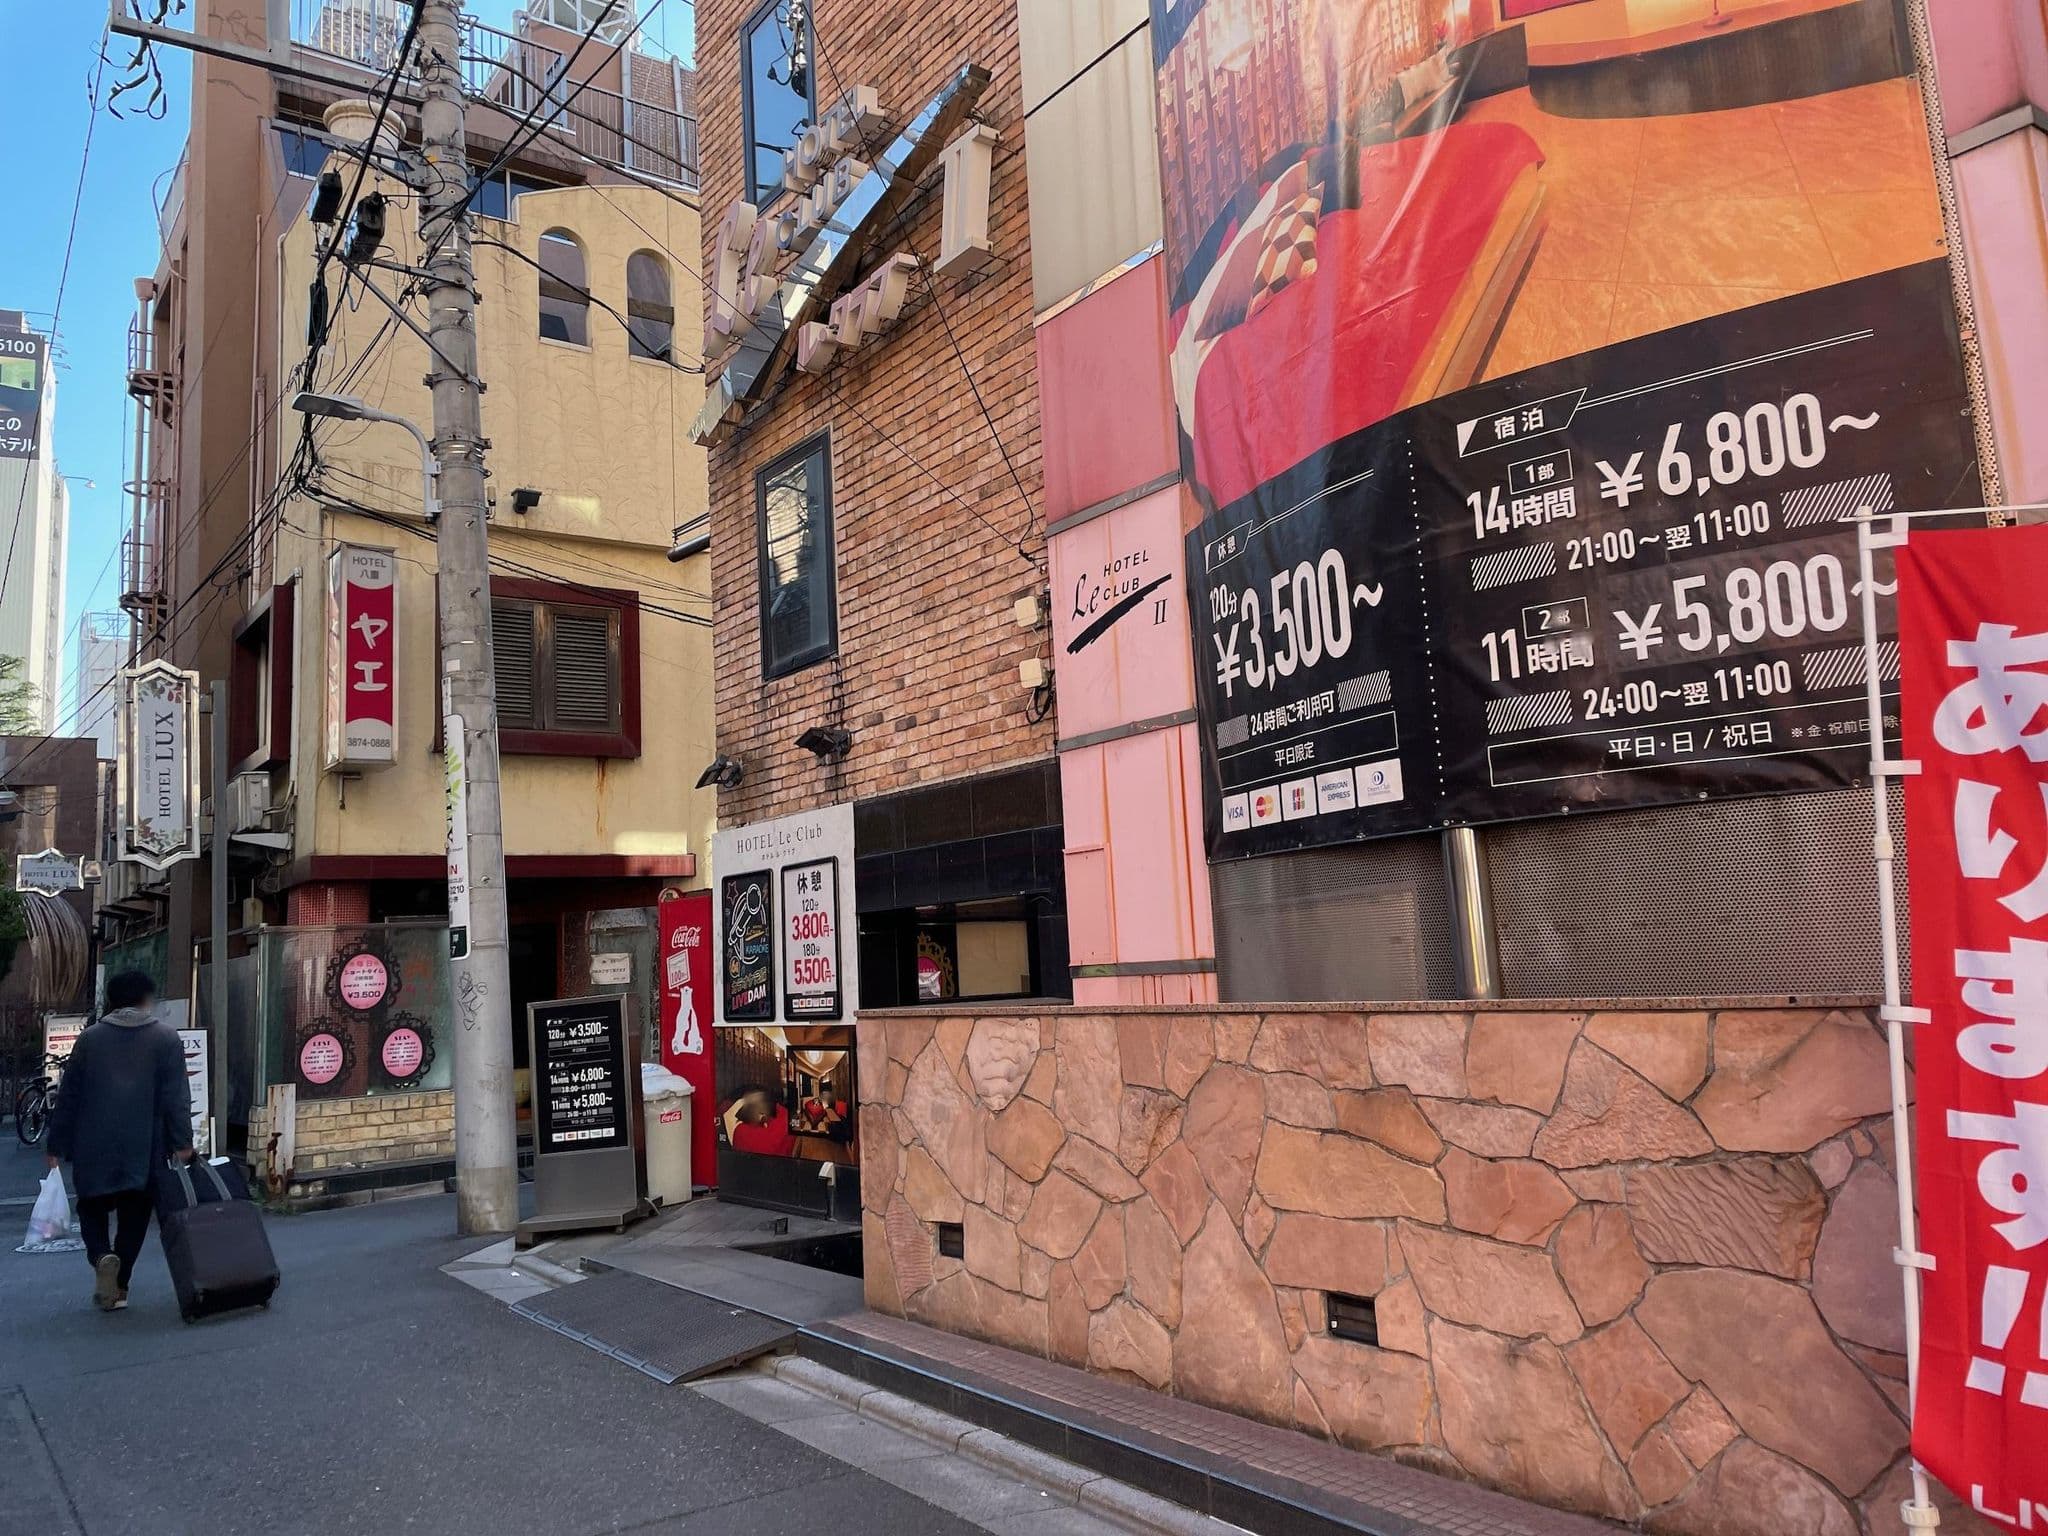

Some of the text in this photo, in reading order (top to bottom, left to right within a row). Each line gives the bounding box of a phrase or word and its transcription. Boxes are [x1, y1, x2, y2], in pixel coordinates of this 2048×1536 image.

[1494, 407, 1545, 440] 宿泊
[1525, 462, 1555, 484] 1部
[1466, 485, 1577, 540] 14時間
[352, 556, 387, 569] HOTEL
[1217, 535, 1237, 561] 休憩
[1103, 549, 1149, 578] HOTEL
[1072, 572, 1140, 622] Le CLUB
[1209, 583, 1238, 624] 120分
[1153, 598, 1168, 626] II
[351, 612, 388, 692] ヤエ
[1250, 689, 1335, 737] 24時間ご利用可
[154, 711, 175, 818] HOTEL LUX
[1274, 741, 1316, 768] 平日限定
[1227, 805, 1244, 820] VISA
[737, 823, 822, 854] HOTEL Le Club
[24, 870, 77, 878] HOTEL LUX
[797, 870, 822, 895] 休憩
[1933, 622, 2048, 1412] あります!
[182, 1039, 202, 1049] UX
